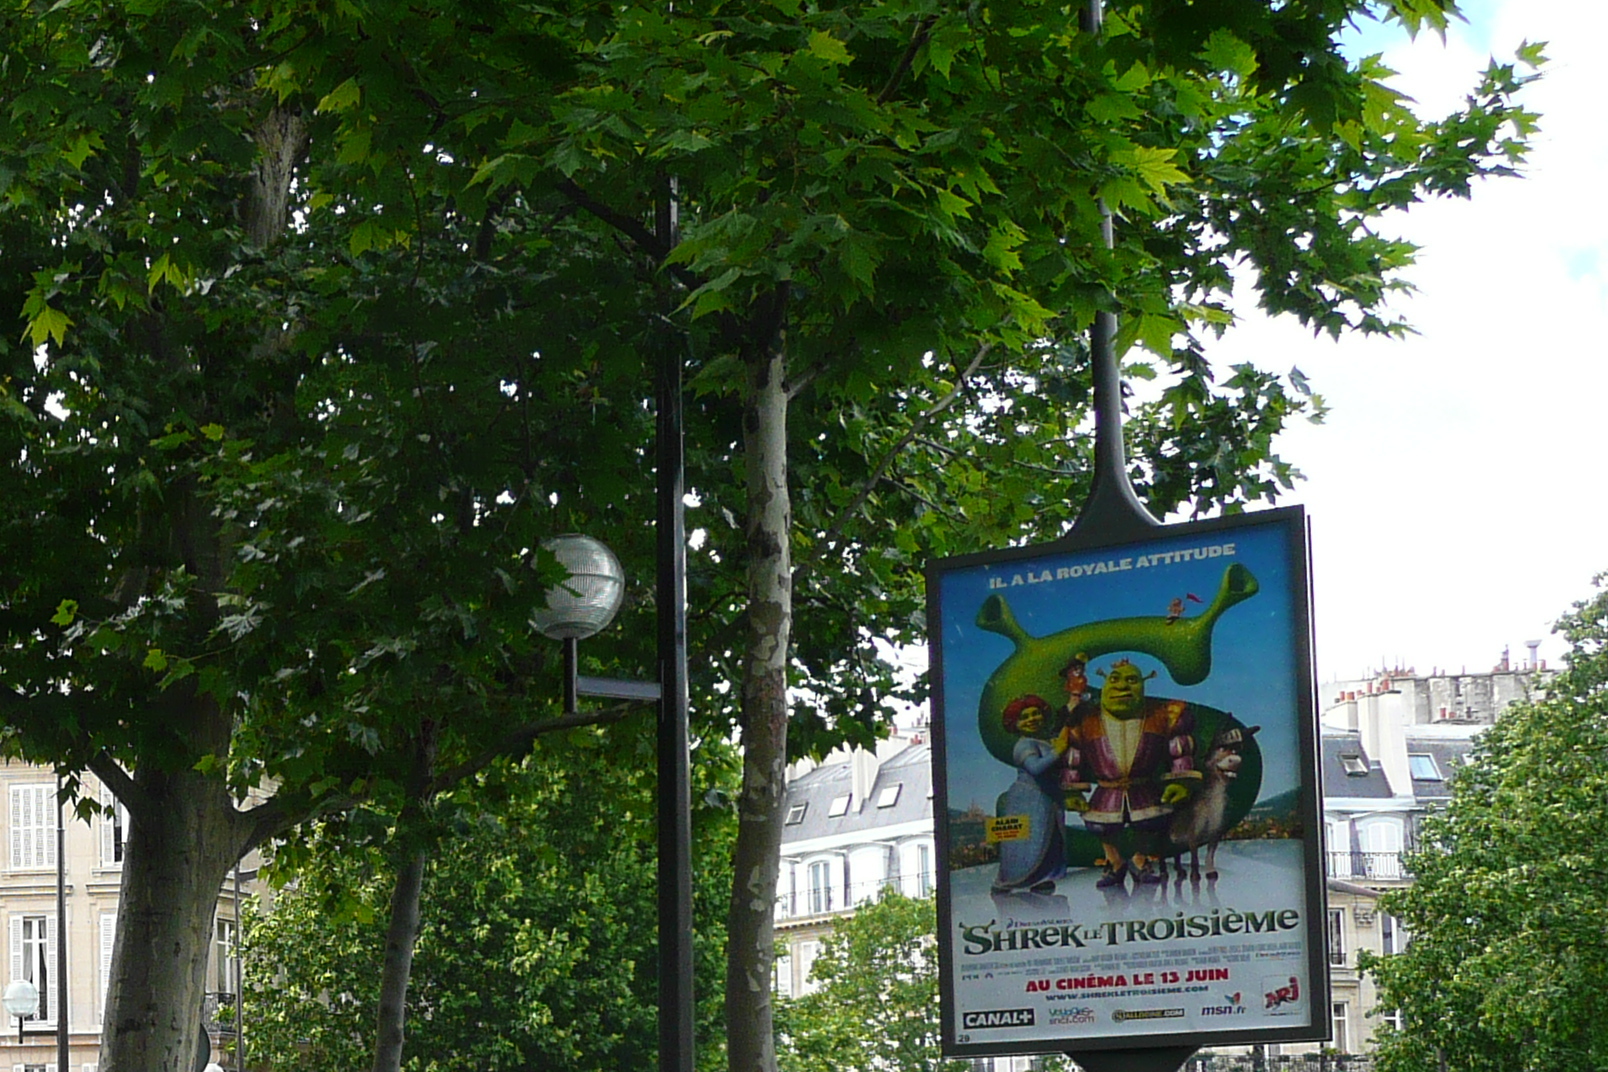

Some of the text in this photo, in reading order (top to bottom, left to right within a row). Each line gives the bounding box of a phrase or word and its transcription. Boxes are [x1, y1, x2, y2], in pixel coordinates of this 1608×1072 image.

[989, 543, 1235, 589] IL A LA ROYALE ATTITUDE
[1083, 928, 1103, 940] LE
[1025, 968, 1229, 992] AU CINÉMA LE 13 JUIN
[1201, 1004, 1247, 1016] msn.fr
[965, 1012, 1033, 1028] CANAL+
